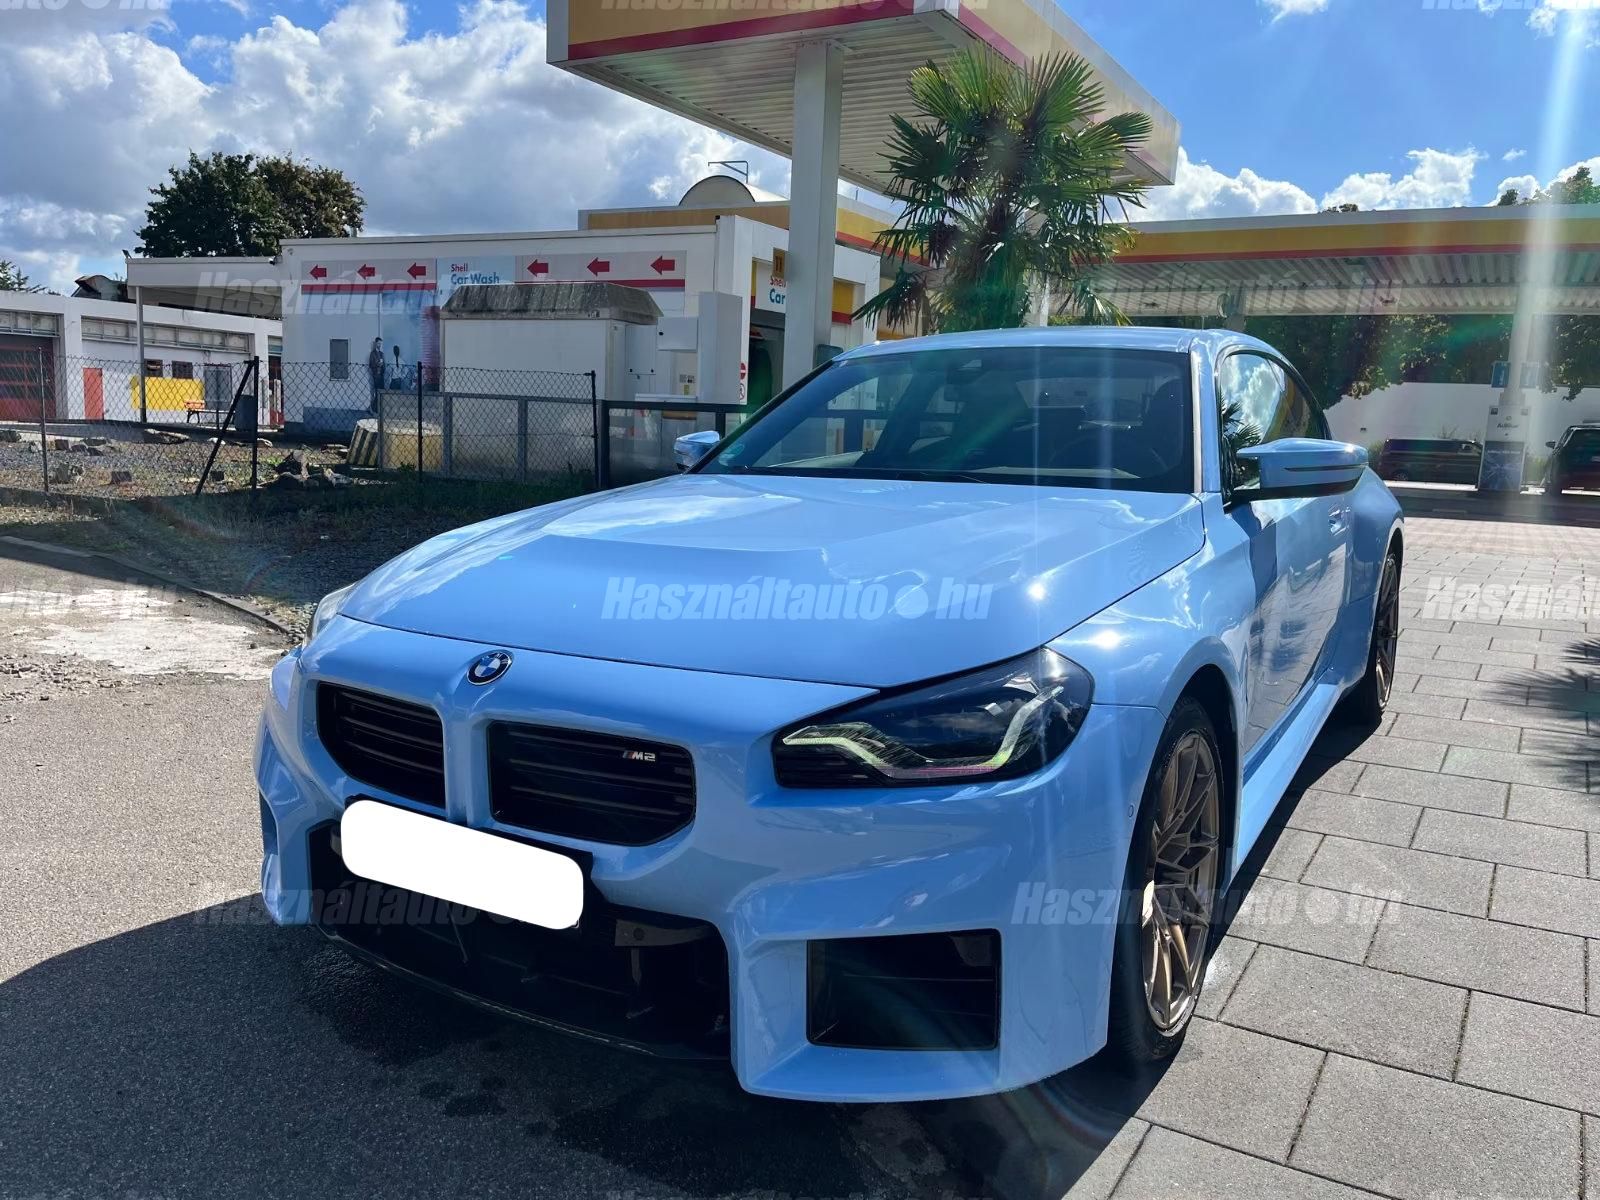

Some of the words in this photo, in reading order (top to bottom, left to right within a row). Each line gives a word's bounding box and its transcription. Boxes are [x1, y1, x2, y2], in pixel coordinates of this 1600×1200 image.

[451, 263, 469, 272] Shell
[451, 274, 468, 285] Car
[470, 272, 500, 285] Wash
[769, 288, 785, 304] Car
